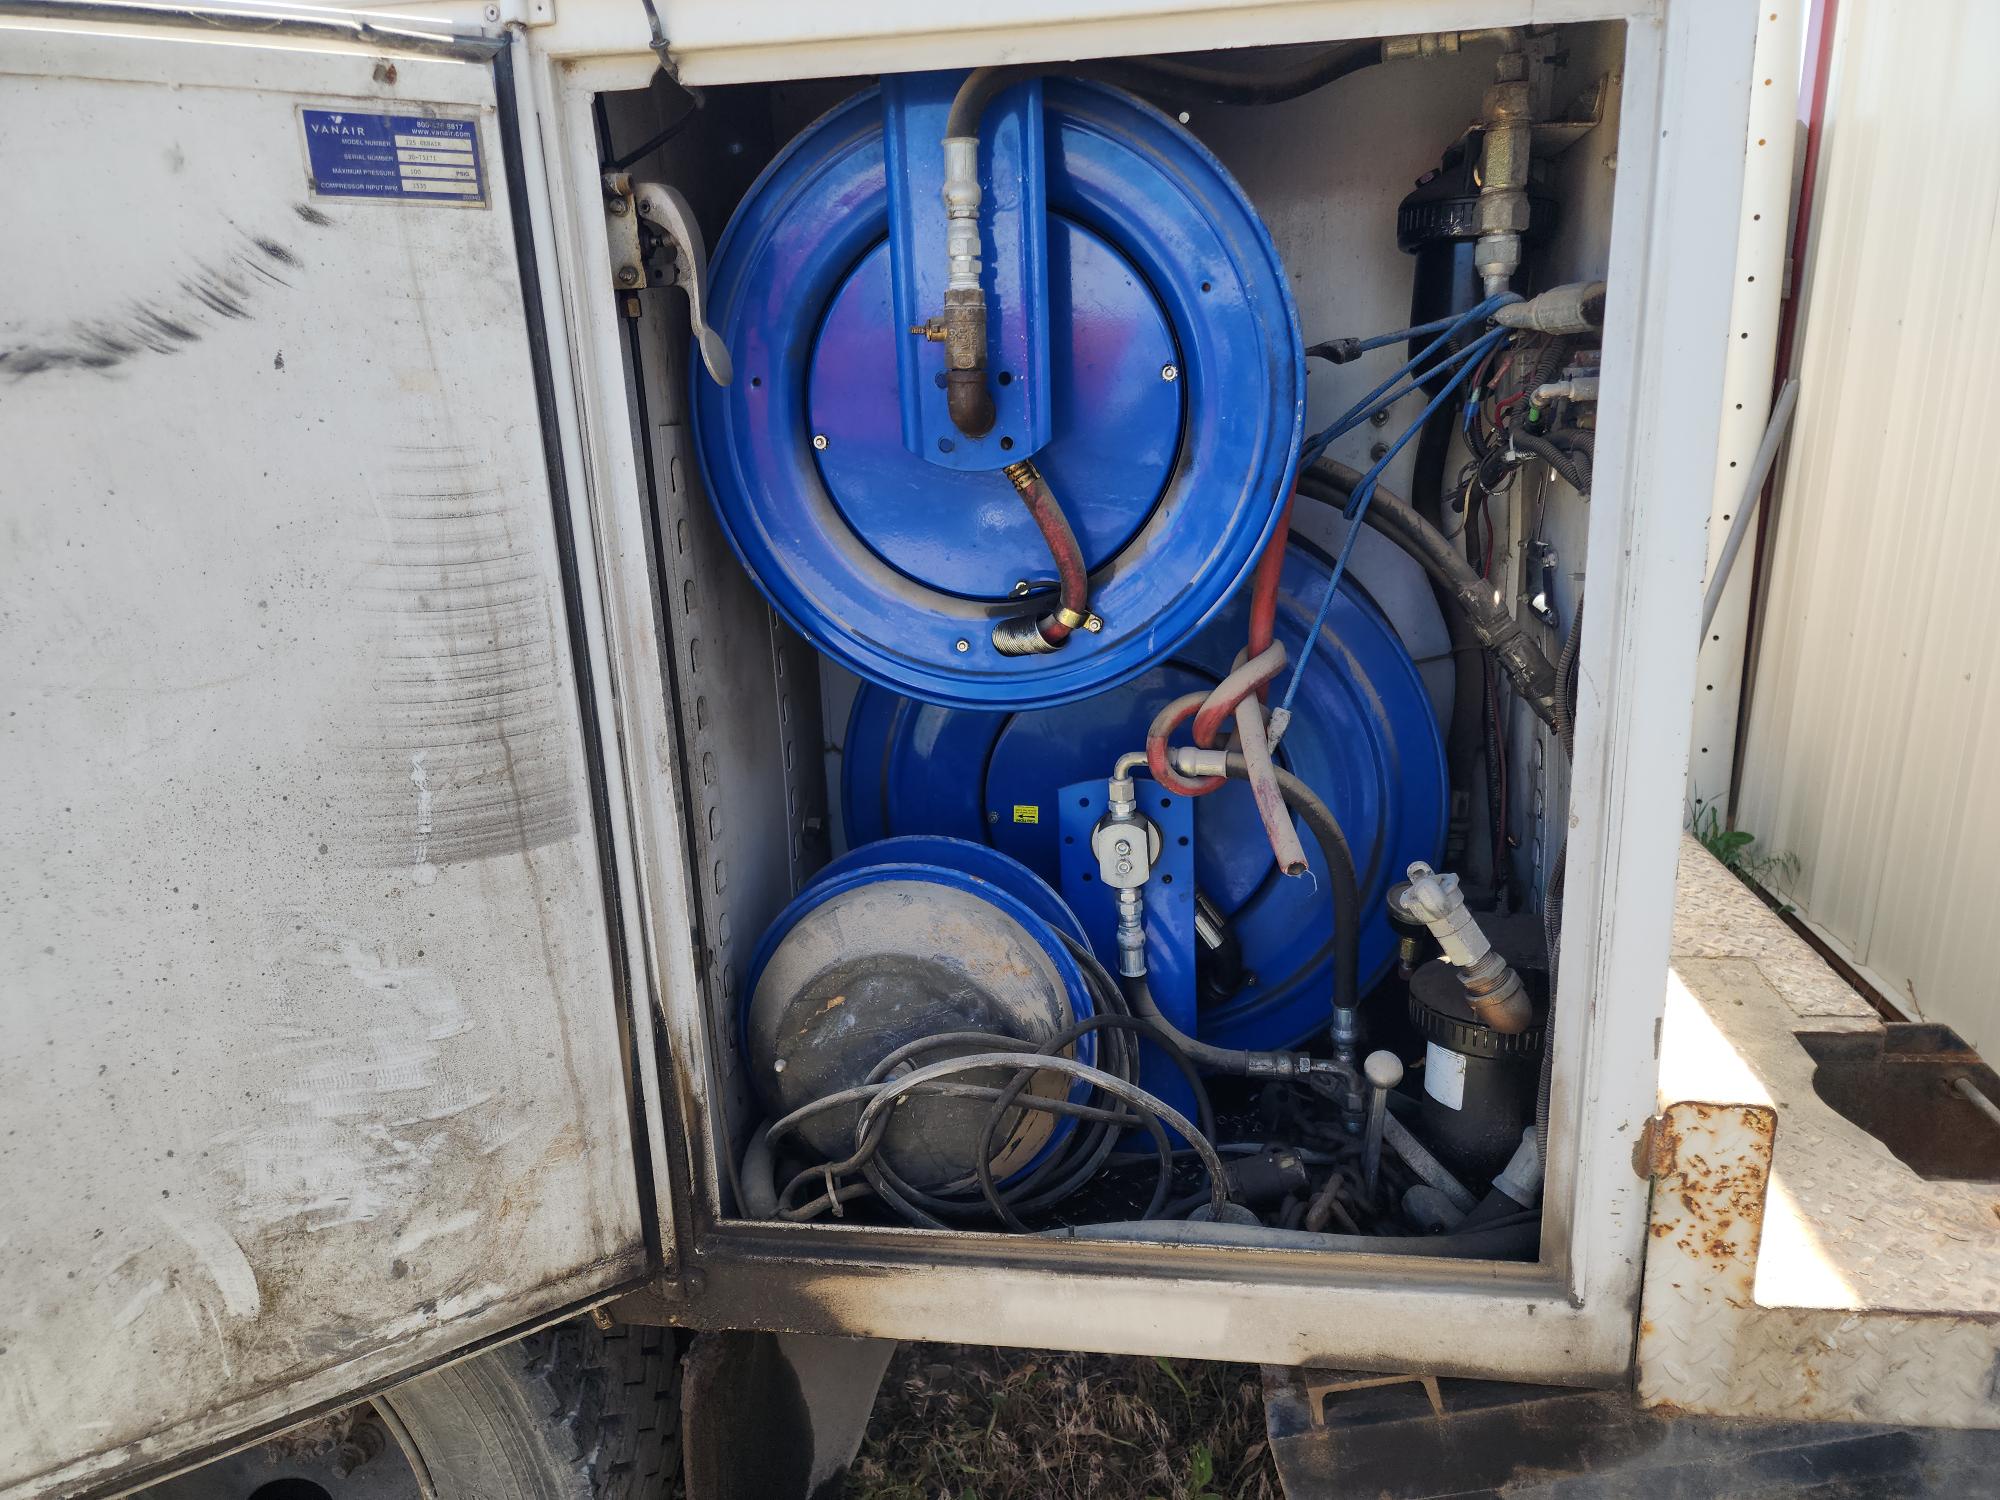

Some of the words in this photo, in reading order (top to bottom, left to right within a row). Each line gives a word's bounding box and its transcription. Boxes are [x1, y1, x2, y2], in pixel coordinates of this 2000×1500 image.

[311, 124, 366, 136] VANAIR
[411, 128, 471, 138] www.vanair.com
[341, 138, 364, 146] MODEL
[365, 139, 391, 147] NUMBER
[332, 167, 362, 175] MAXIMUM
[363, 168, 396, 177] PRESSURE
[320, 182, 364, 190] COMPRESSOR
[365, 183, 383, 191] INPUT
